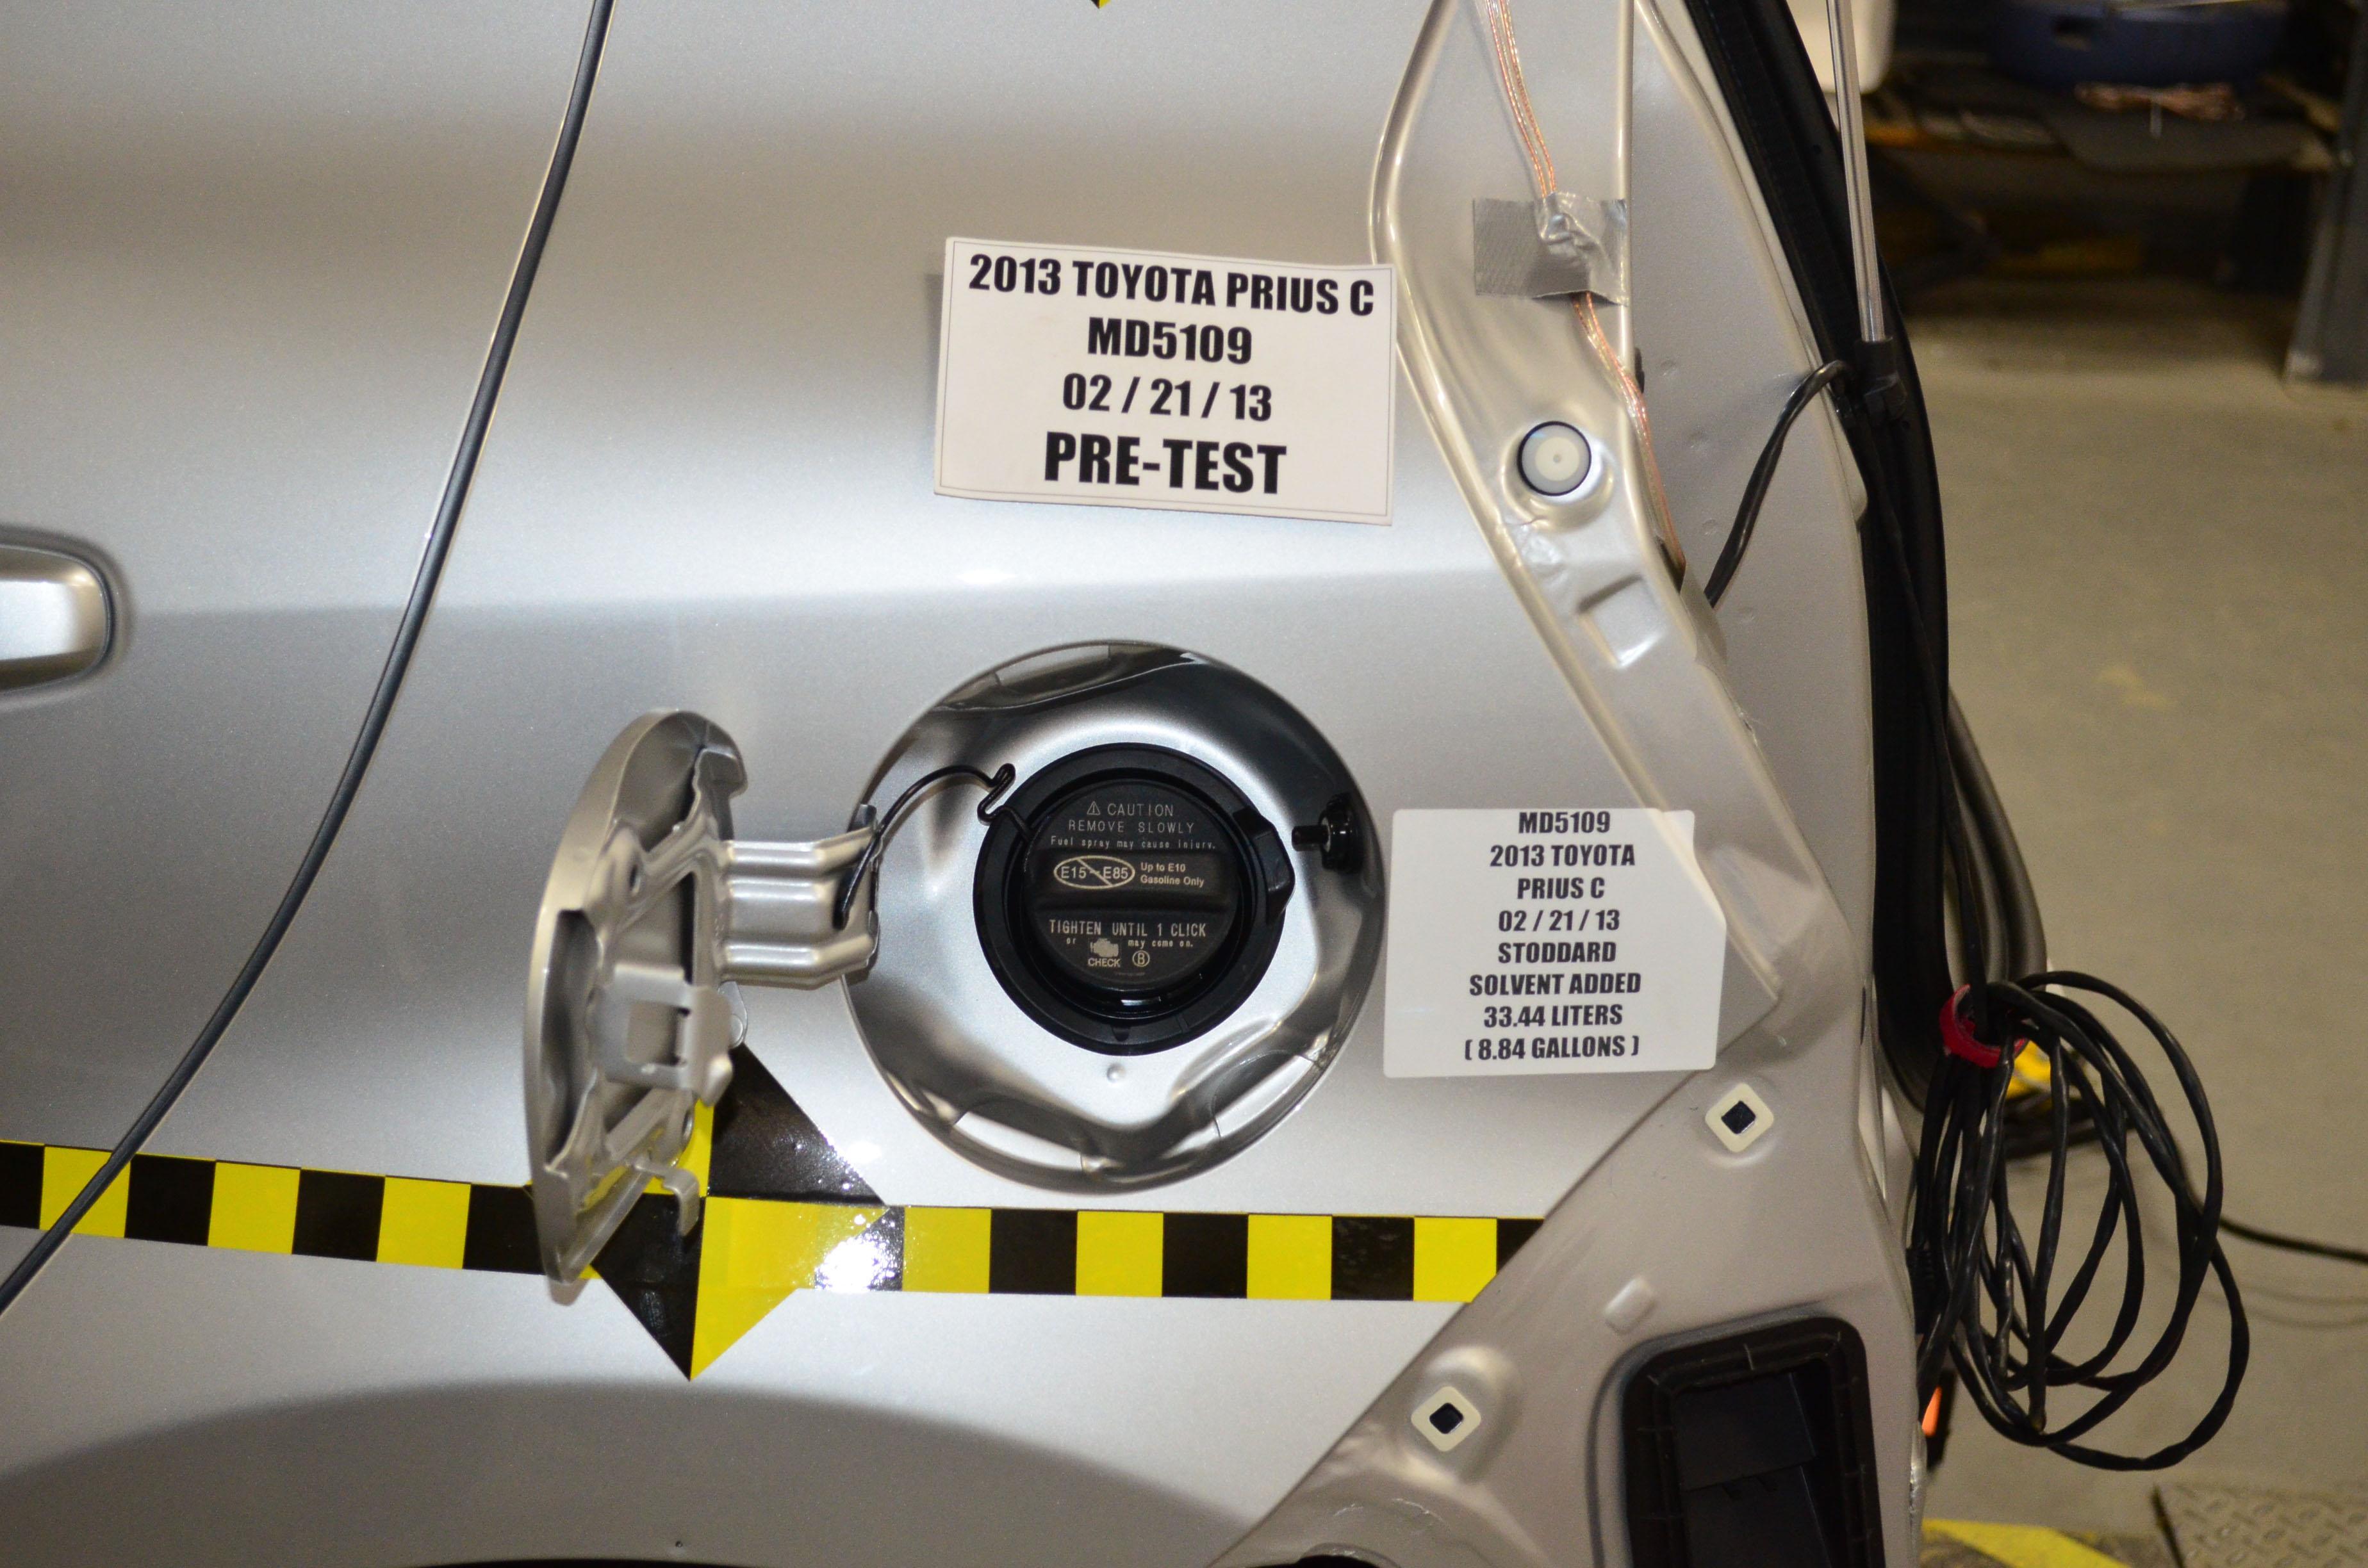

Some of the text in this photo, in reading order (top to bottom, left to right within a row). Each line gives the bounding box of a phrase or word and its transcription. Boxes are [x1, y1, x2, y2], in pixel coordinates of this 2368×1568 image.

[969, 254, 1373, 316] 2013 TOYOTA PRIUS C
[1089, 318, 1251, 364] MD5109
[1064, 373, 1111, 411] 02
[1151, 379, 1190, 416] 21
[1230, 385, 1271, 421] 13
[1046, 432, 1286, 493] PRE-TEST
[1107, 803, 1174, 816] CAUTION
[1069, 819, 1194, 833] REMOVE SLOWLY
[1519, 812, 1609, 833] MD5109
[1051, 836, 1074, 845] Fuel
[1081, 838, 1110, 849] spray
[1117, 840, 1133, 849] may
[1491, 845, 1634, 866] 2013 TOYOTA
[1140, 863, 1186, 872] Up to E10
[1140, 875, 1205, 887] Gasoline Only
[1518, 878, 1604, 899] PRIUS C
[1049, 919, 1206, 936] TIGHTEN UNTIL 1 CLICK
[1499, 911, 1526, 931] 02
[1550, 910, 1572, 931] 21
[1596, 910, 1619, 930] 13
[1128, 940, 1145, 949] may
[1499, 942, 1616, 963] STODDARD
[1088, 958, 1121, 967] CHECK
[1470, 973, 1640, 995] SOLVENT ADDED
[1484, 1004, 1622, 1027] 33.44 LITERS
[1479, 1039, 1525, 1059] 8.84
[1532, 1036, 1624, 1058] GALLONS
